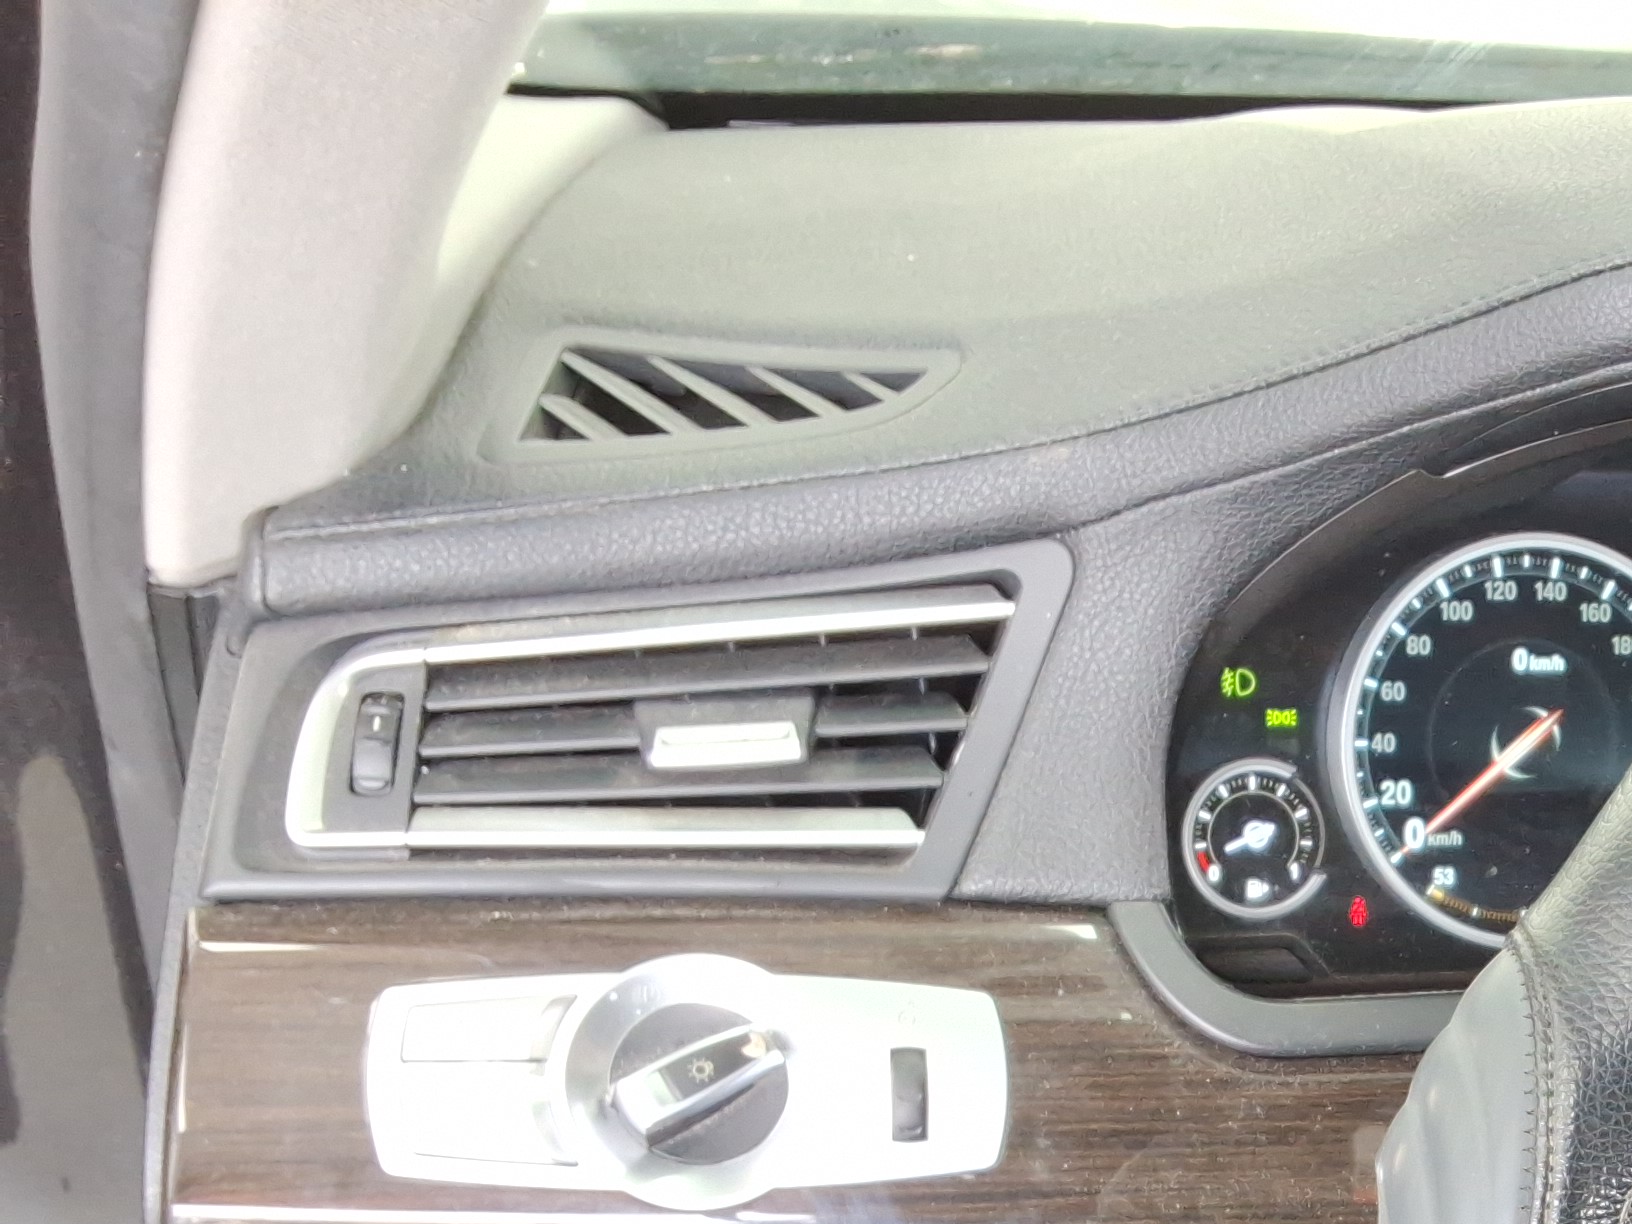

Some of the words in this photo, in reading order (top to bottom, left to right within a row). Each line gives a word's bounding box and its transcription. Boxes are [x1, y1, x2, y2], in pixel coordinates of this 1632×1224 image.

[1484, 580, 1518, 601] 120
[1535, 582, 1568, 602] 140
[1440, 600, 1474, 621] 100
[1579, 603, 1613, 623] 160
[1405, 634, 1432, 656] 80
[1512, 647, 1530, 675] 0
[1530, 655, 1567, 672] km/h
[1381, 681, 1406, 701] 60
[1371, 732, 1396, 753] 40
[1380, 779, 1413, 805] 20
[1403, 818, 1426, 849] 0
[1428, 830, 1463, 846] km/h
[1208, 865, 1219, 881] 0
[1433, 866, 1455, 885] 53
